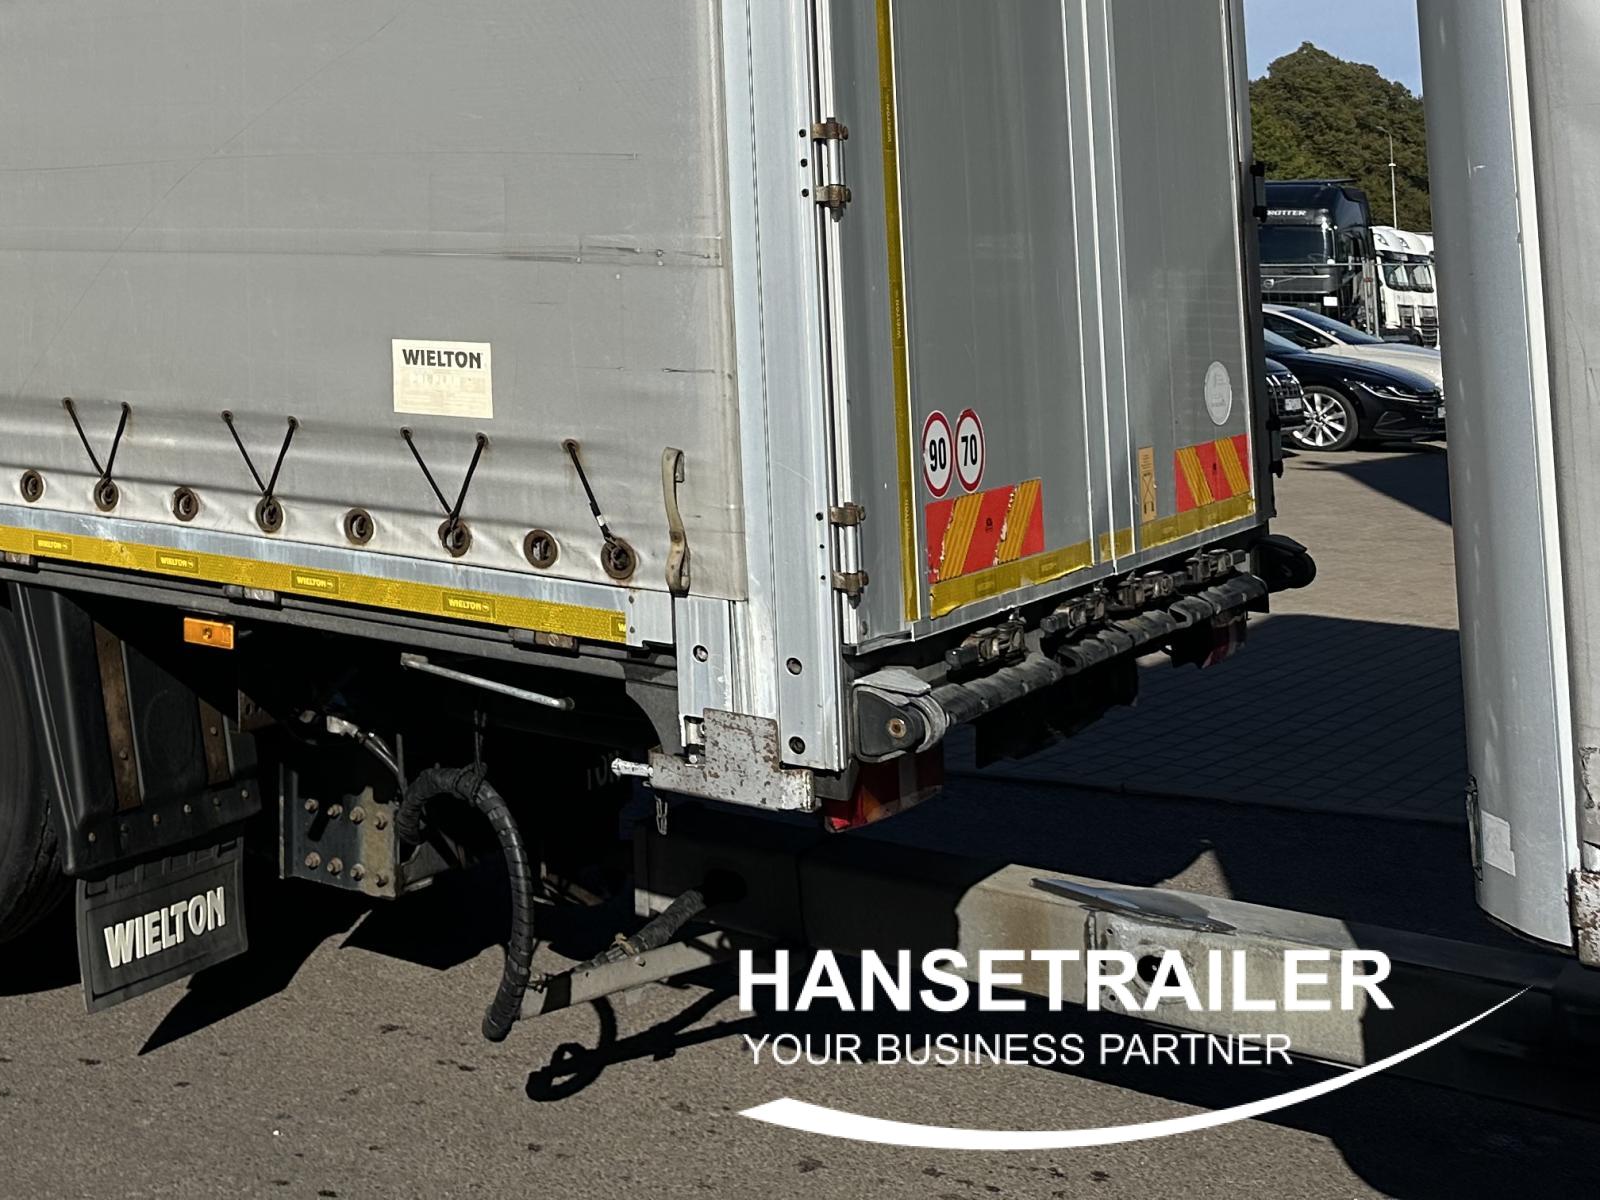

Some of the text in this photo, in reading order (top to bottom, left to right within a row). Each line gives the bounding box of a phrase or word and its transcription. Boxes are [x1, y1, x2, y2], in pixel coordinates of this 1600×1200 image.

[402, 349, 481, 369] WIELTON
[929, 437, 947, 472] 90
[961, 434, 978, 467] 70
[160, 556, 188, 568] WIELTON
[296, 576, 326, 588] WIELTON
[448, 598, 482, 611] WIELTON
[103, 886, 226, 969] WIELTON
